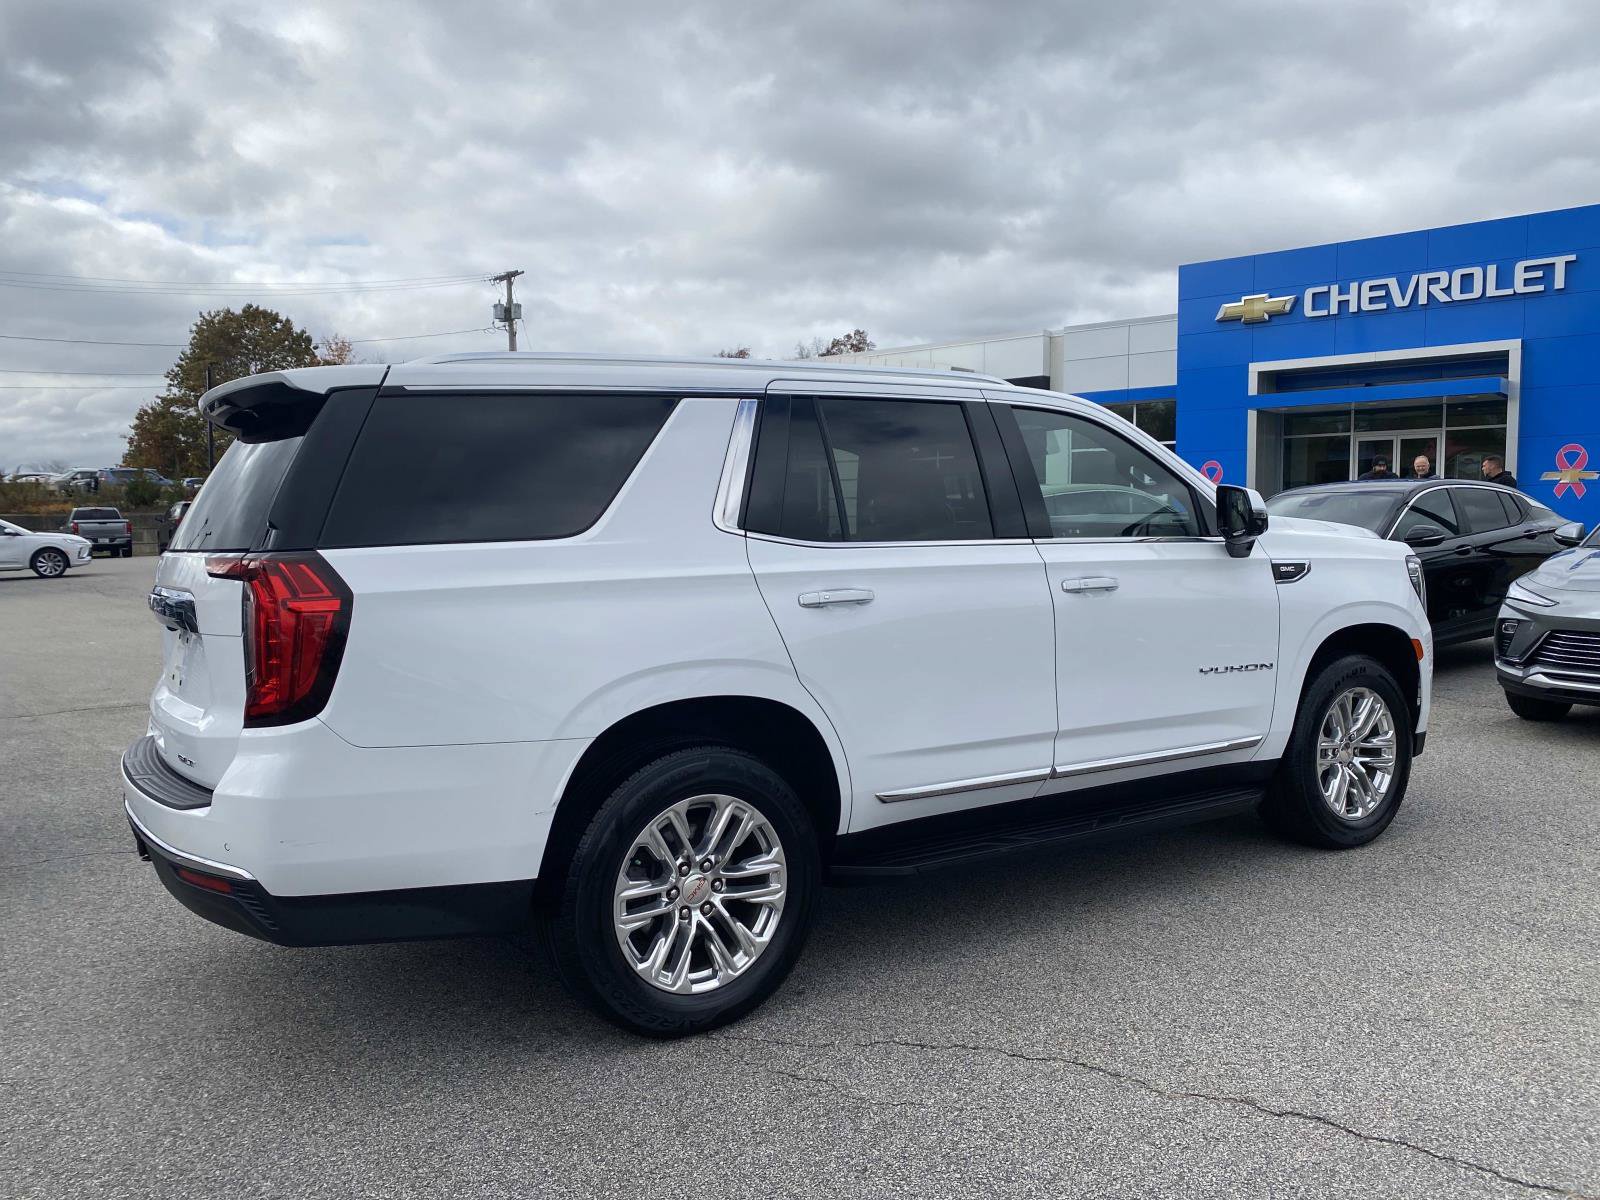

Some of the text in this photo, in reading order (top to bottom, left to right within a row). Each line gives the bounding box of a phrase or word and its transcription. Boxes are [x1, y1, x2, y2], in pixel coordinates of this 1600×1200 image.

[1303, 254, 1577, 318] CHEVROLET
[1199, 662, 1273, 675] YUKON
[687, 877, 706, 901] GMC
